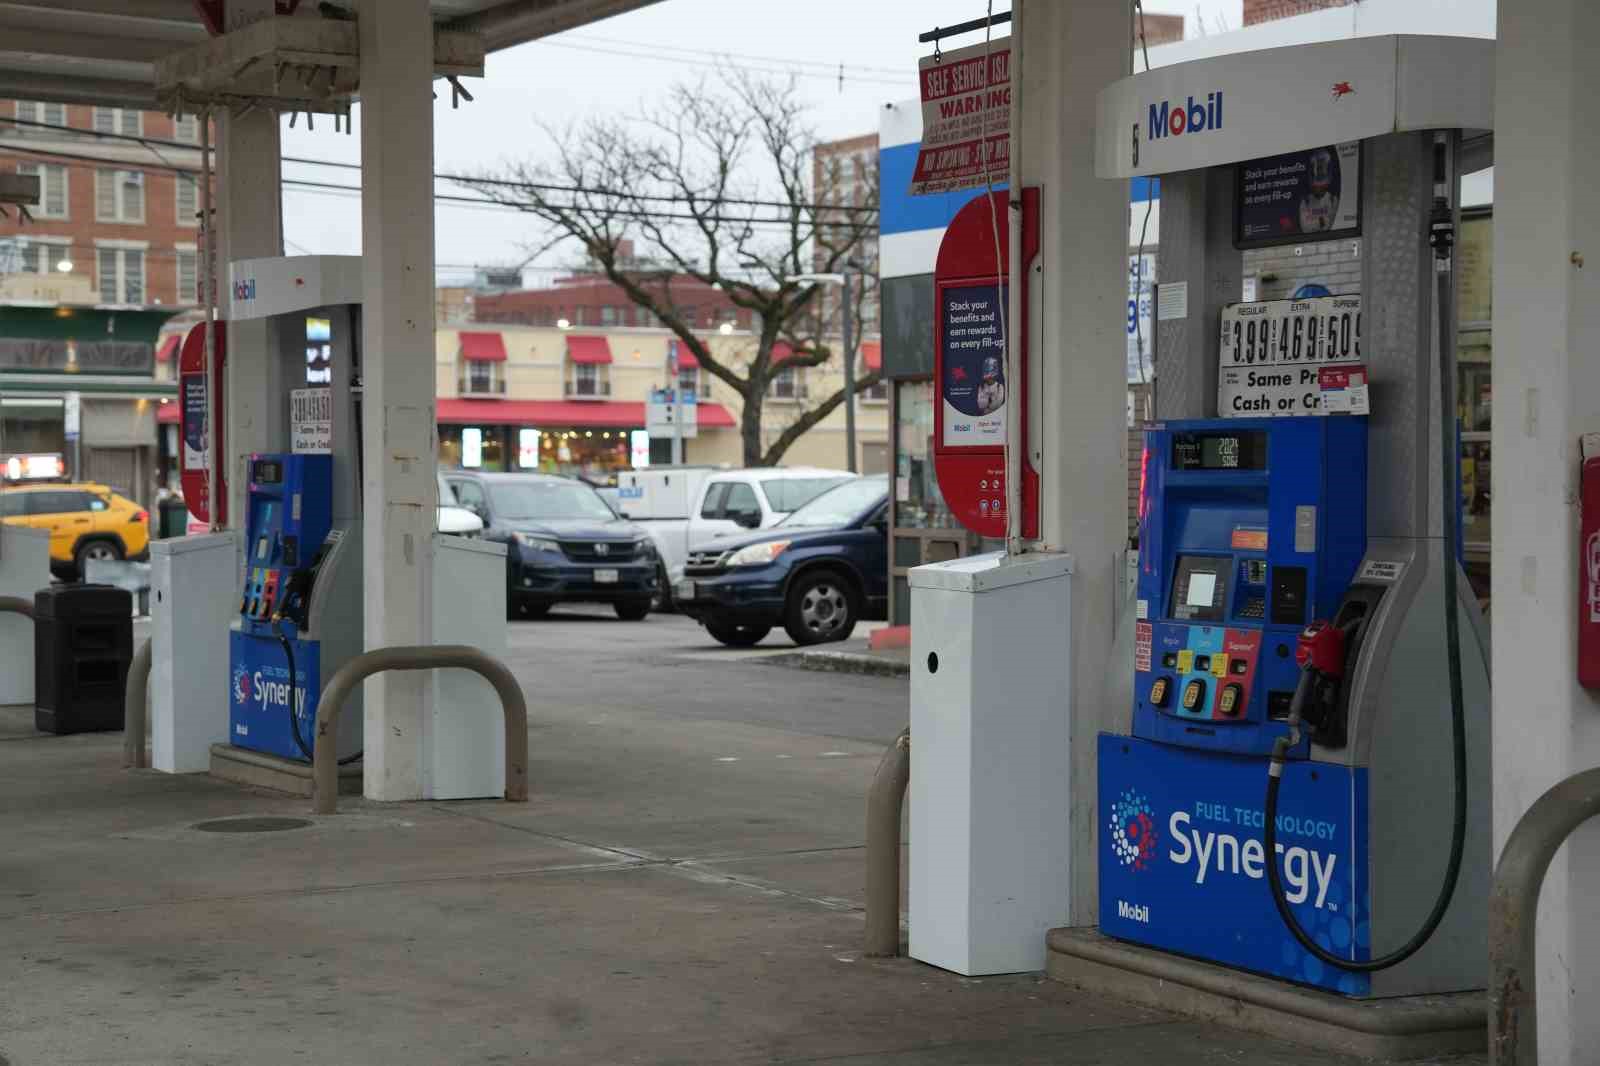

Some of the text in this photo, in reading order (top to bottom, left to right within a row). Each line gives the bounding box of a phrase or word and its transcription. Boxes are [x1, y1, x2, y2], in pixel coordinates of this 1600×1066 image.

[927, 55, 1009, 98] SELF SERVIC ISL
[1148, 91, 1223, 141] Mobil
[1132, 122, 1139, 169] 5
[950, 299, 988, 312] Stack your
[1290, 302, 1311, 312] EXTRA
[950, 311, 995, 323] benefits and
[950, 324, 997, 336] earn rewards
[950, 341, 960, 349] on
[960, 340, 980, 350] every
[1233, 318, 1269, 363] 3.99
[1279, 315, 1319, 361] 4.69
[1247, 371, 1292, 387] Same
[1232, 394, 1271, 411] Cash
[1277, 396, 1296, 410] or
[1195, 801, 1231, 823] FUEL
[1118, 899, 1149, 924] Mobil
